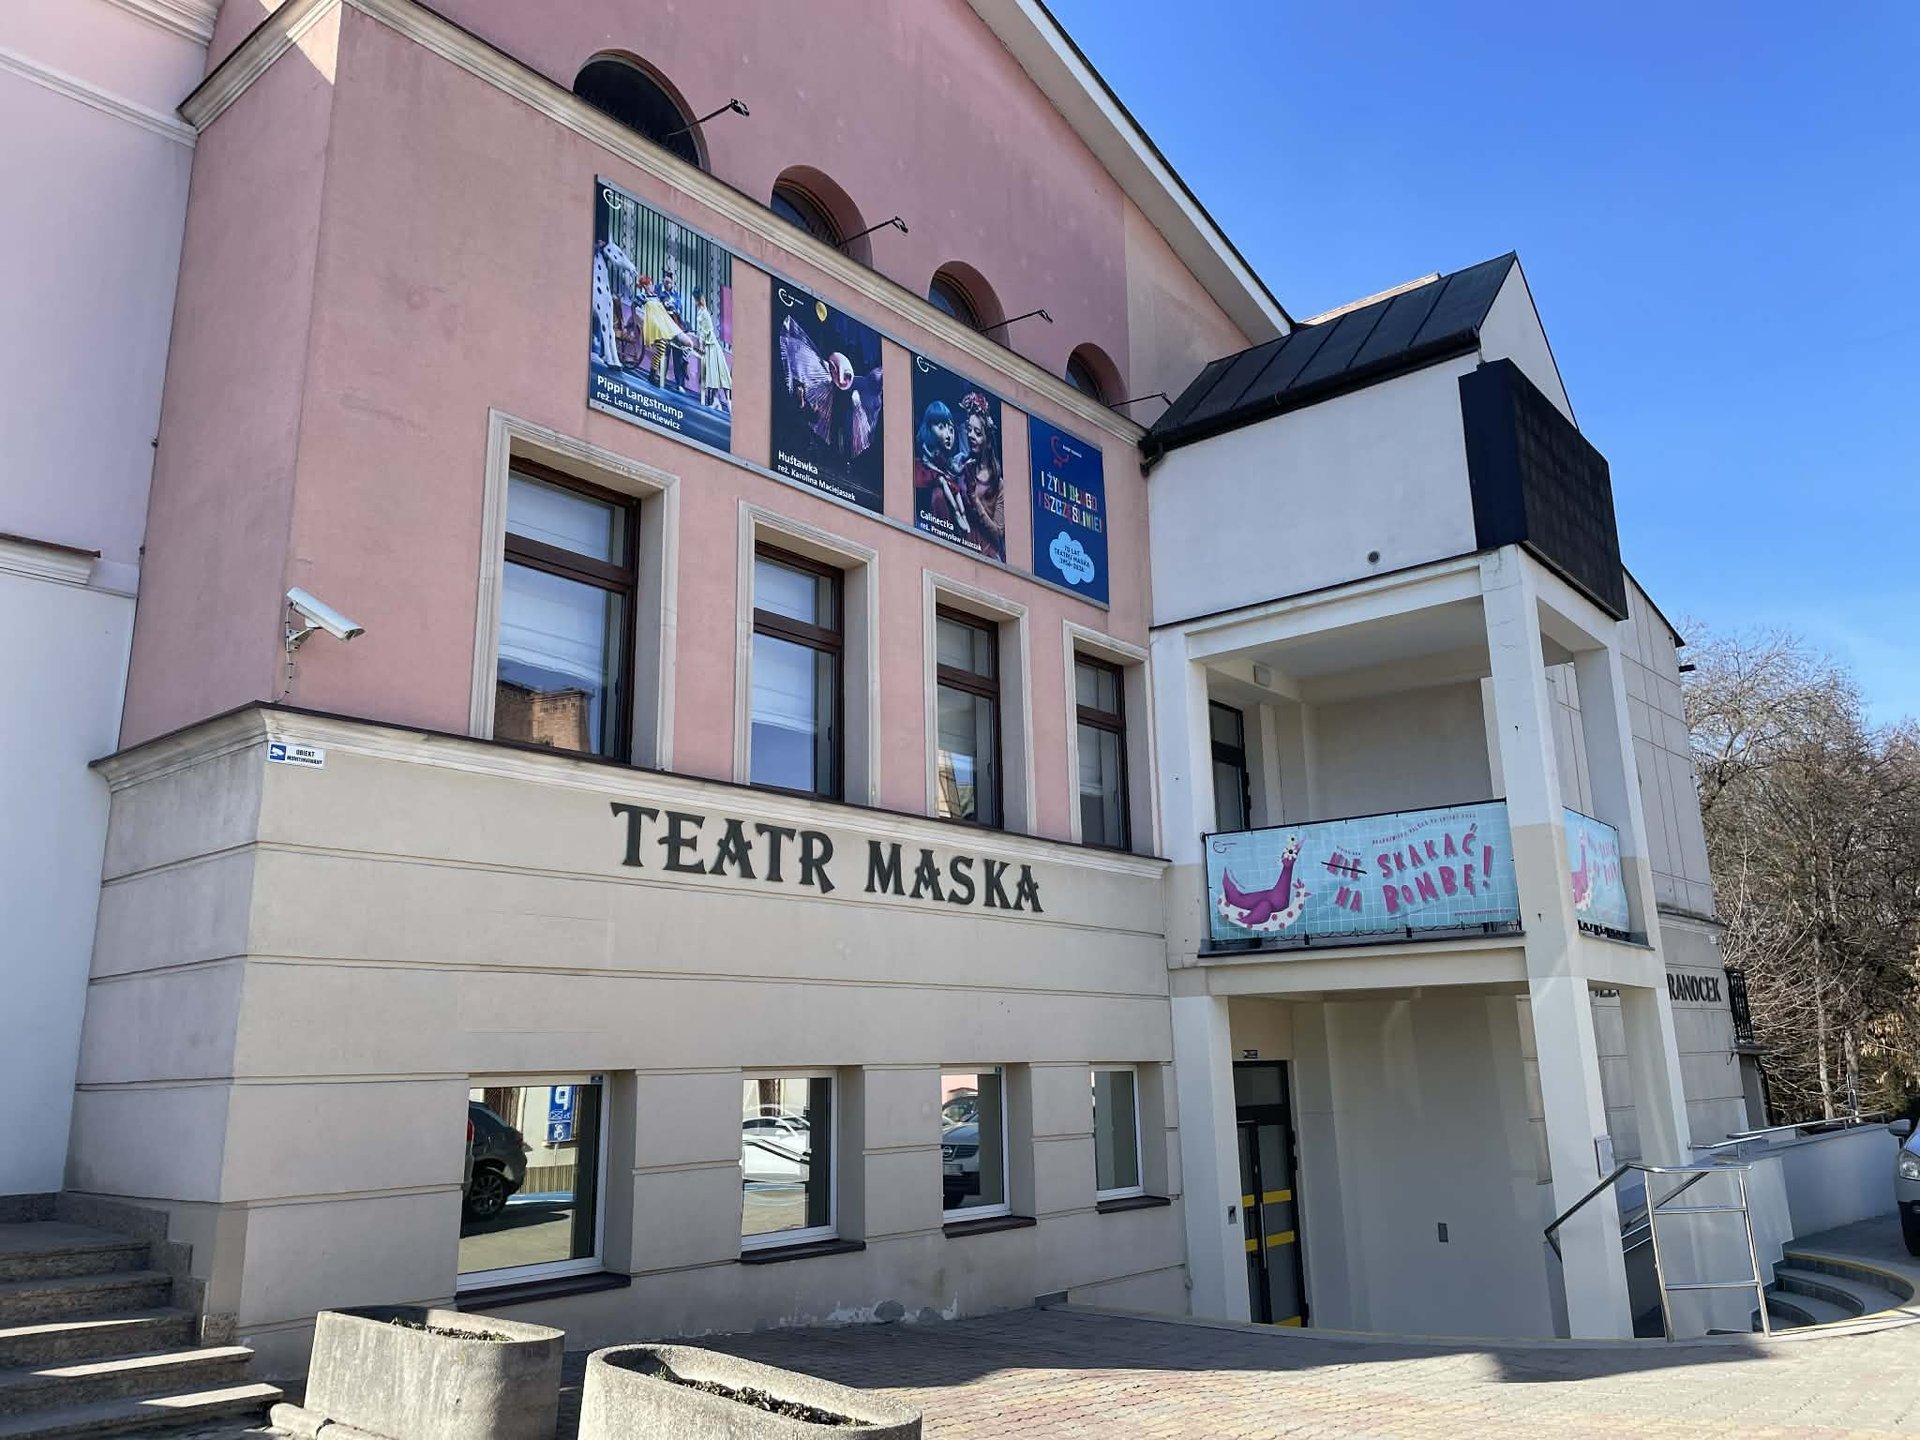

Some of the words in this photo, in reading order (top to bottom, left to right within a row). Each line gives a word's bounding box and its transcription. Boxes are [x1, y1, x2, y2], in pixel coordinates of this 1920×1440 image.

[597, 375, 623, 394] Pippi
[626, 387, 684, 419] Langstrump
[597, 391, 612, 403] reż.
[614, 396, 633, 411] Lena
[635, 405, 681, 430] Frankiewicz
[777, 464, 790, 475] reż.
[791, 469, 818, 486] Karolina
[778, 450, 818, 475] Huśtawka
[1046, 471, 1067, 498] ŻYLI
[920, 510, 954, 531] Calineczka
[296, 749, 315, 757] OBIEKT
[610, 802, 835, 894] TEATR
[865, 840, 1045, 913] MASKA
[1377, 822, 1477, 879] SKAKAĆ
[1335, 886, 1362, 912] NA
